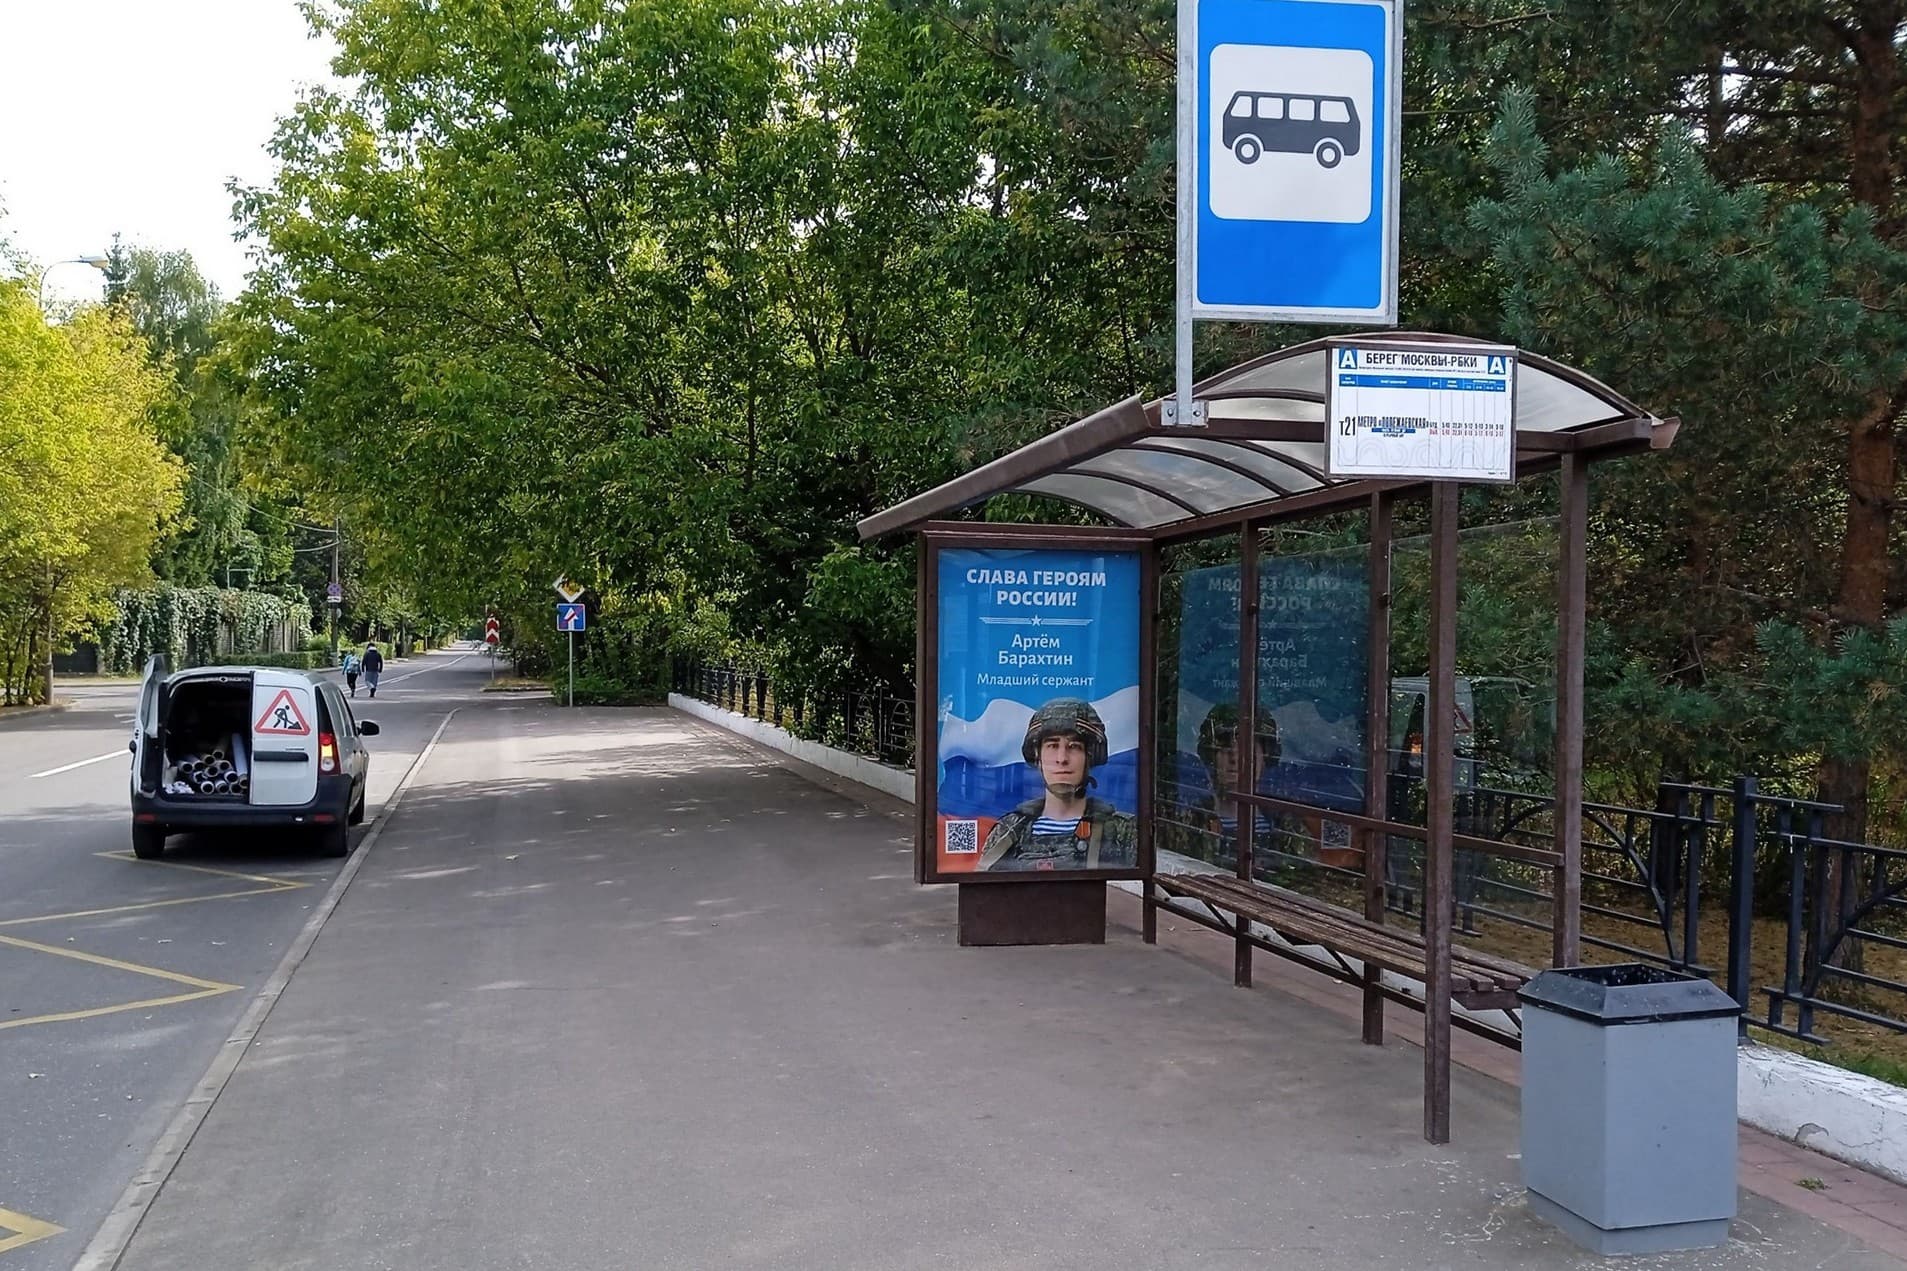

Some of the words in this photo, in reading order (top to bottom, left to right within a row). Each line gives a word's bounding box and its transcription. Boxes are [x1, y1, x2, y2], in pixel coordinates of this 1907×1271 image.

[1366, 352, 1398, 365] БЕРЕГ
[966, 568, 1029, 585] СЛАВА
[1033, 570, 1107, 587] ГЕРОЯМ
[996, 590, 1078, 607] РОССИИ!
[1011, 634, 1060, 651] Артём
[998, 650, 1073, 668] Барахтин
[976, 673, 1040, 687] Младший
[1041, 675, 1095, 689] сержант
